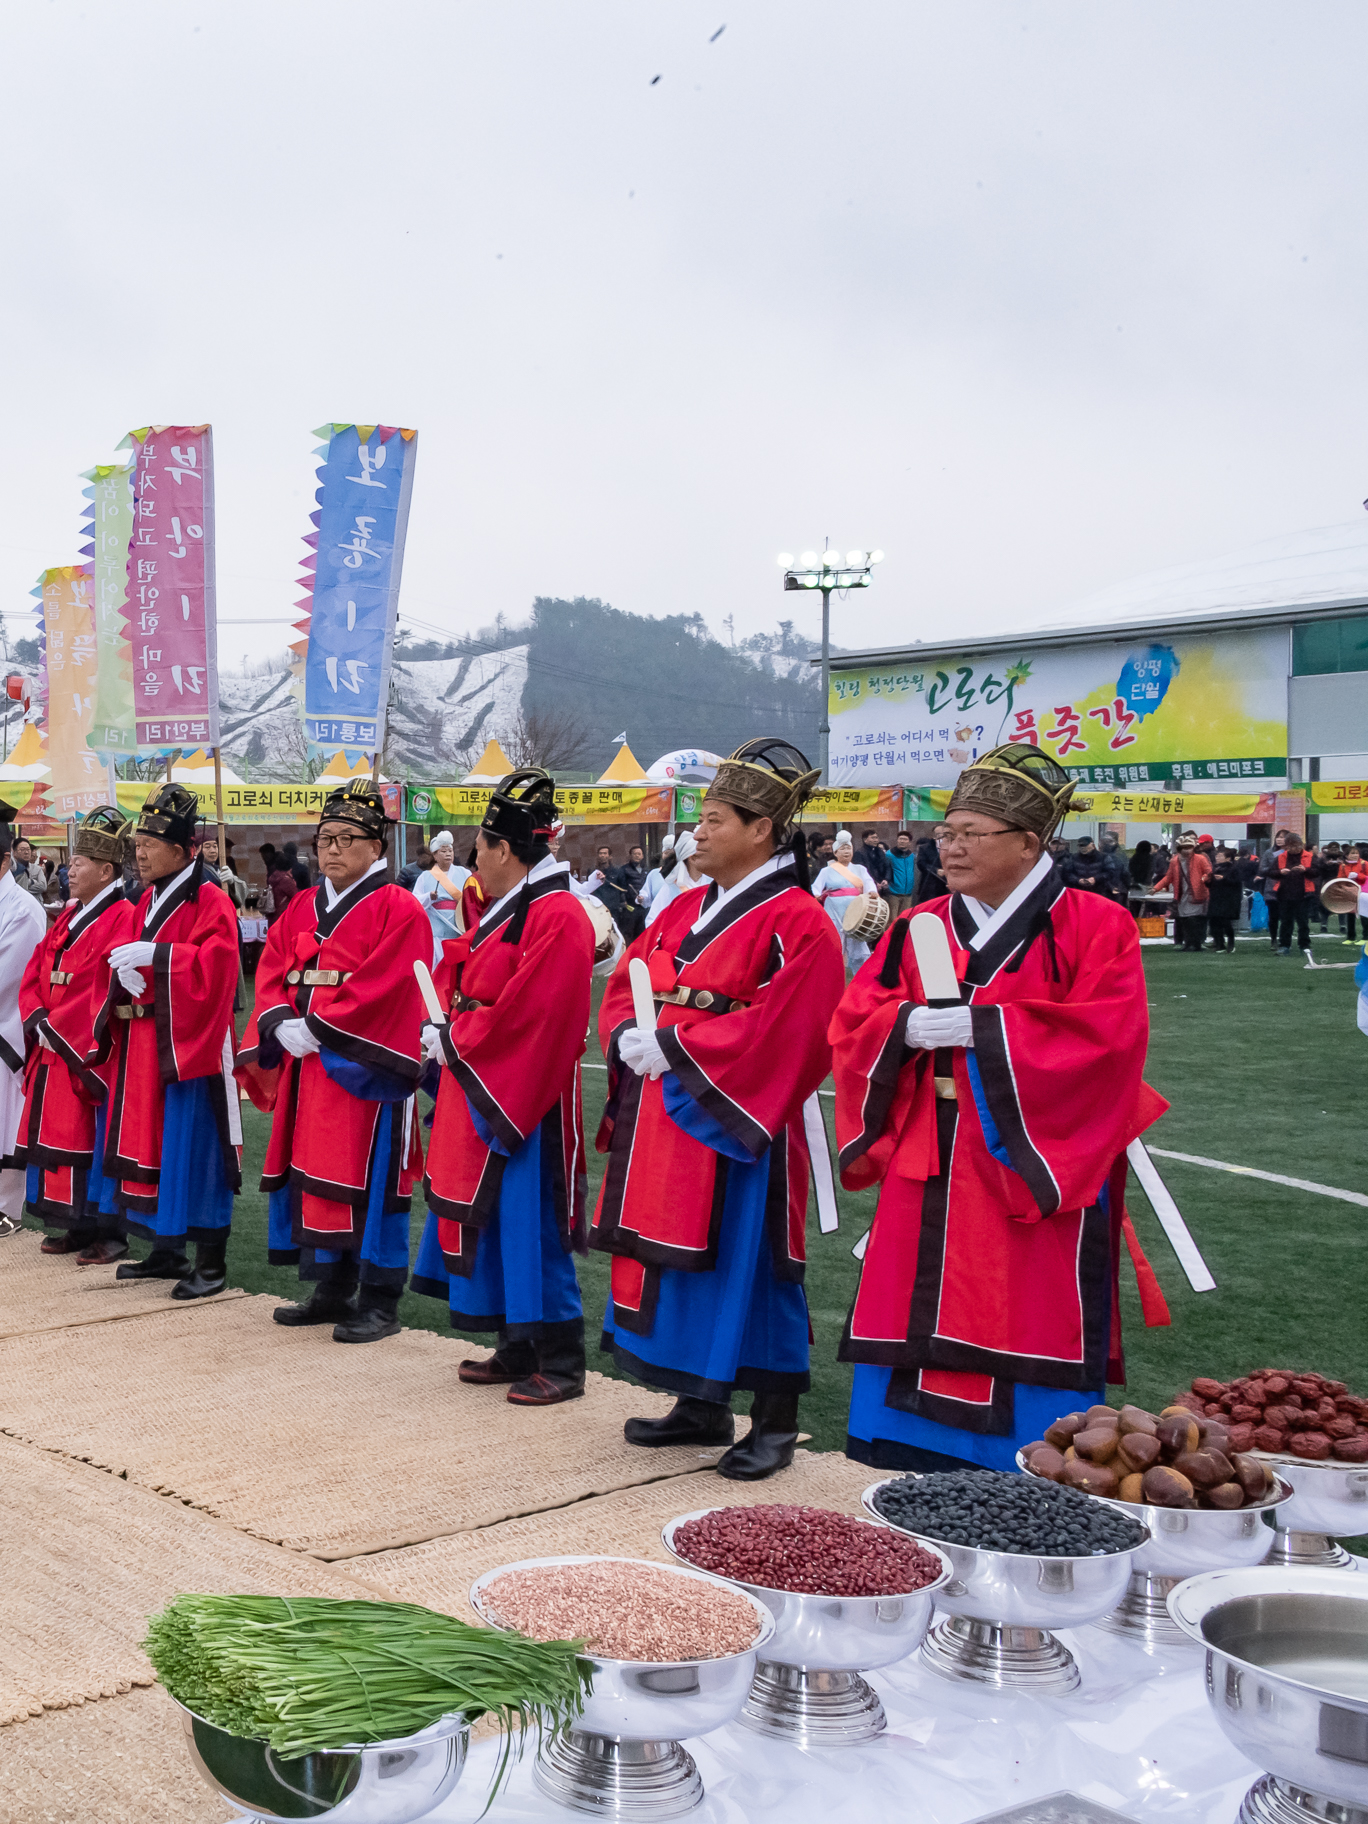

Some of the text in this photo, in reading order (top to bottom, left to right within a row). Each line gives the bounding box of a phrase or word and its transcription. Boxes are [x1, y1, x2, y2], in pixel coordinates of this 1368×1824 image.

[1133, 659, 1162, 678] 양평
[1131, 683, 1160, 700] 단월
[834, 666, 1019, 740] 힐링 청정단월 고로쇠
[900, 729, 935, 744] 어디서
[938, 728, 949, 741] 먹
[974, 725, 984, 741] ?
[831, 753, 869, 768] 여기양평
[873, 751, 906, 766] 단월서
[910, 749, 944, 764] 먹으면
[1094, 767, 1115, 782] 추진
[1119, 766, 1150, 781] 위원회
[1172, 763, 1193, 779] 후원
[227, 790, 273, 807] 고로쇠
[598, 791, 623, 804] 판매
[1111, 795, 1134, 812] 웃는
